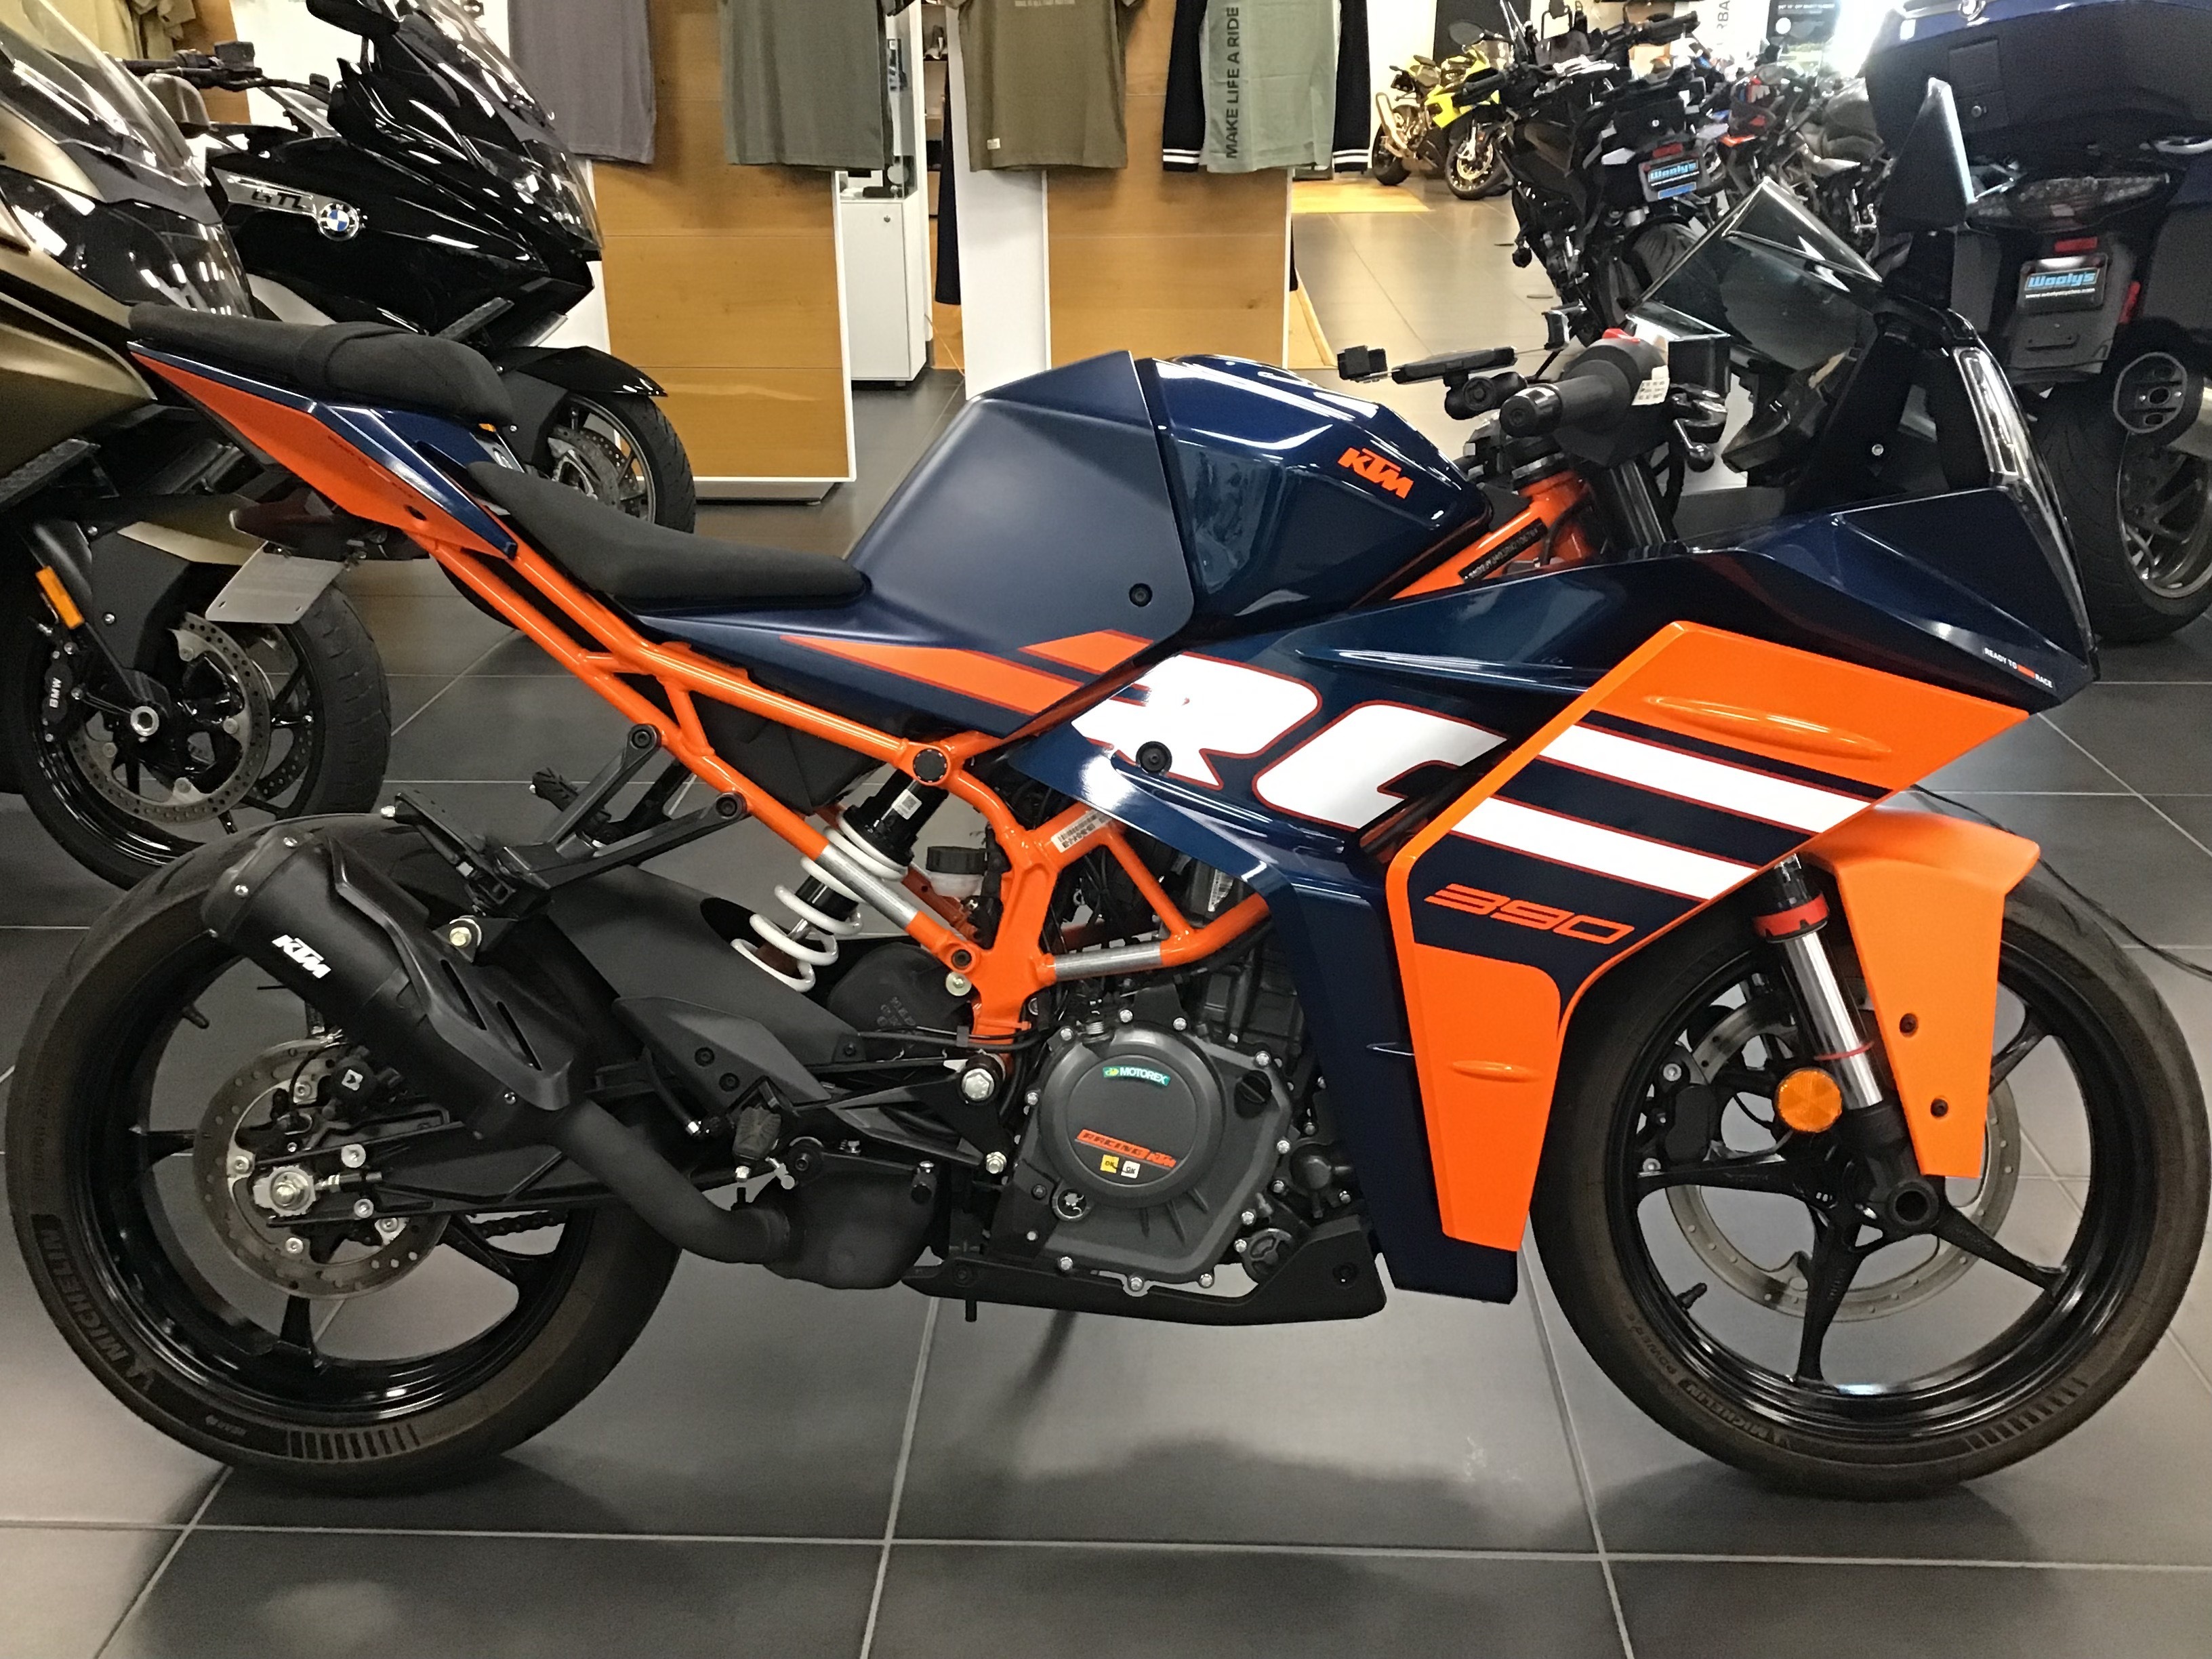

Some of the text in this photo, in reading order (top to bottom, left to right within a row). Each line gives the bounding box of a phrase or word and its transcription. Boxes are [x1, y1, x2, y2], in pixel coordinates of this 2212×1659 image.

[1226, 7, 1240, 159] MAKE LIFE A RIDE
[1338, 447, 1414, 499] KTM
[1984, 647, 2053, 689] READY TO RACE
[49, 678, 62, 708] BMW
[1424, 883, 1635, 945] 390
[272, 935, 331, 979] KTM
[1120, 1067, 1166, 1084] MOTOREX
[1083, 1132, 1142, 1156] RACING
[41, 1229, 129, 1361] MICHELIN
[1686, 1383, 1770, 1438] MICHELIN
